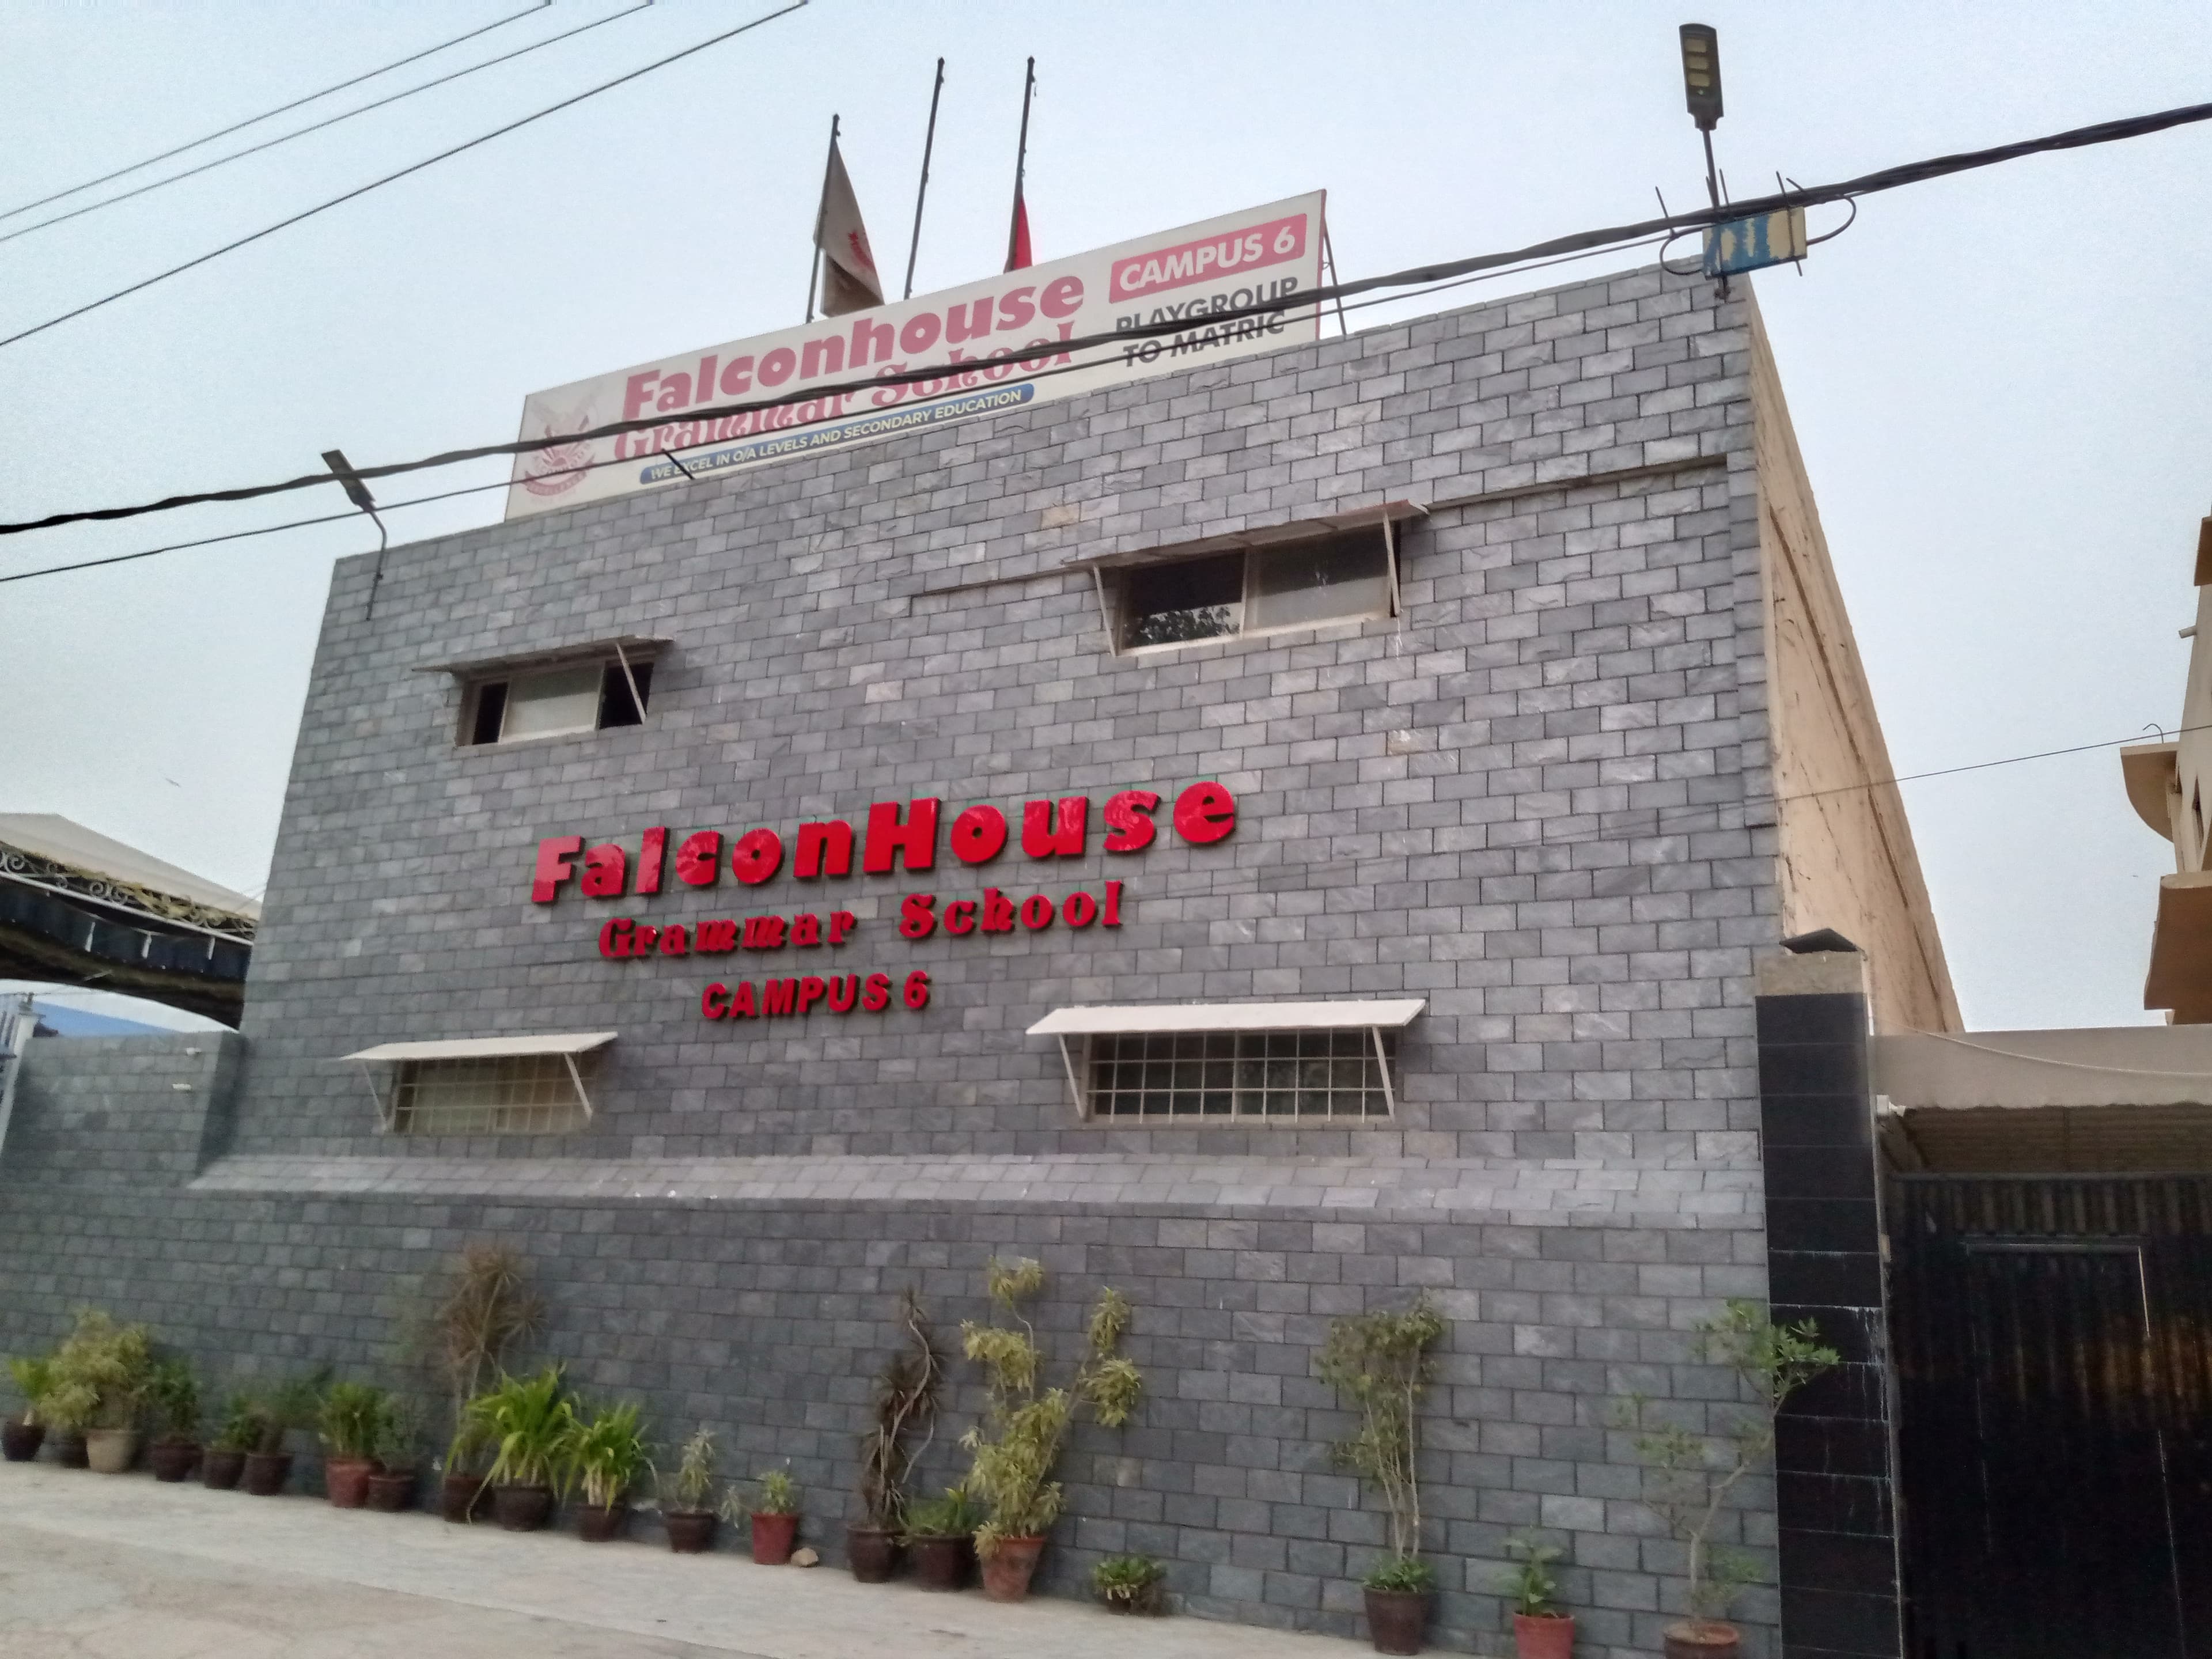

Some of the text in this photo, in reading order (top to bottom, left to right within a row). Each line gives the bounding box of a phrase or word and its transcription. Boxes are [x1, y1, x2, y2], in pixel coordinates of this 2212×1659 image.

[1119, 226, 1295, 291] CAMPUS 6
[1116, 276, 1298, 332] PLAYGROUP
[1123, 311, 1285, 368] TO MATRIC
[622, 276, 1084, 421] Falconhouse
[651, 389, 1022, 480] WE EXCEL IN O/A LEVELS AND SECONDARY EDUCATION
[531, 781, 1234, 903] FalconHouse
[597, 880, 1123, 958] Grammar School
[700, 970, 929, 1019] CAMPUS 6
